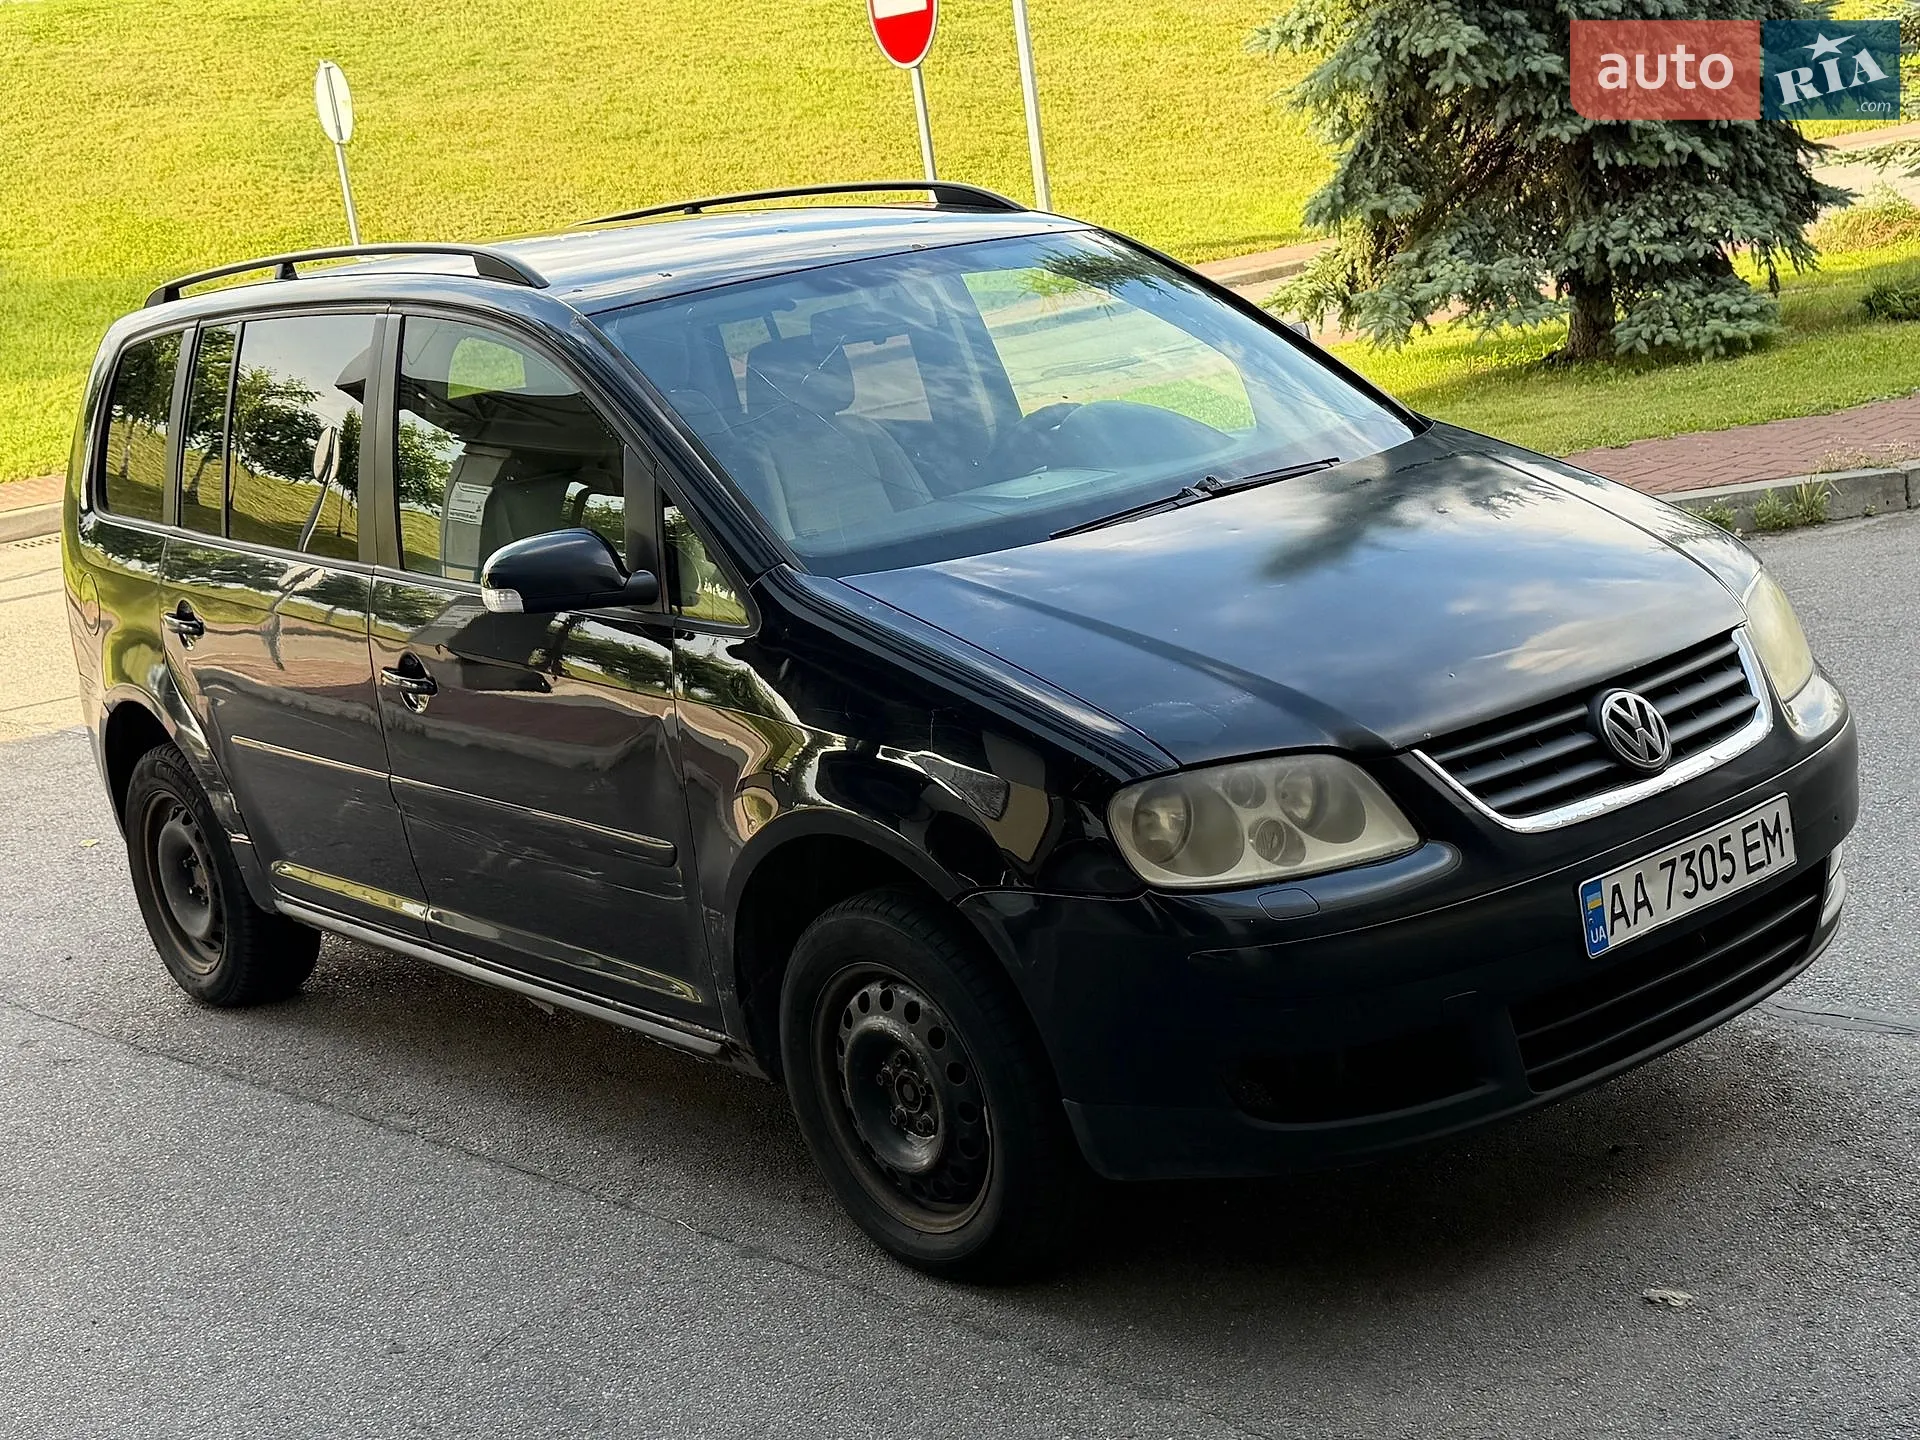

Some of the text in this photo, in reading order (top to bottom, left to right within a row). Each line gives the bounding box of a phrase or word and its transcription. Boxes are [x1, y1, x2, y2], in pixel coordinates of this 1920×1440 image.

[1609, 811, 1785, 937] AA 7305 EM
[1590, 925, 1607, 944] UA
